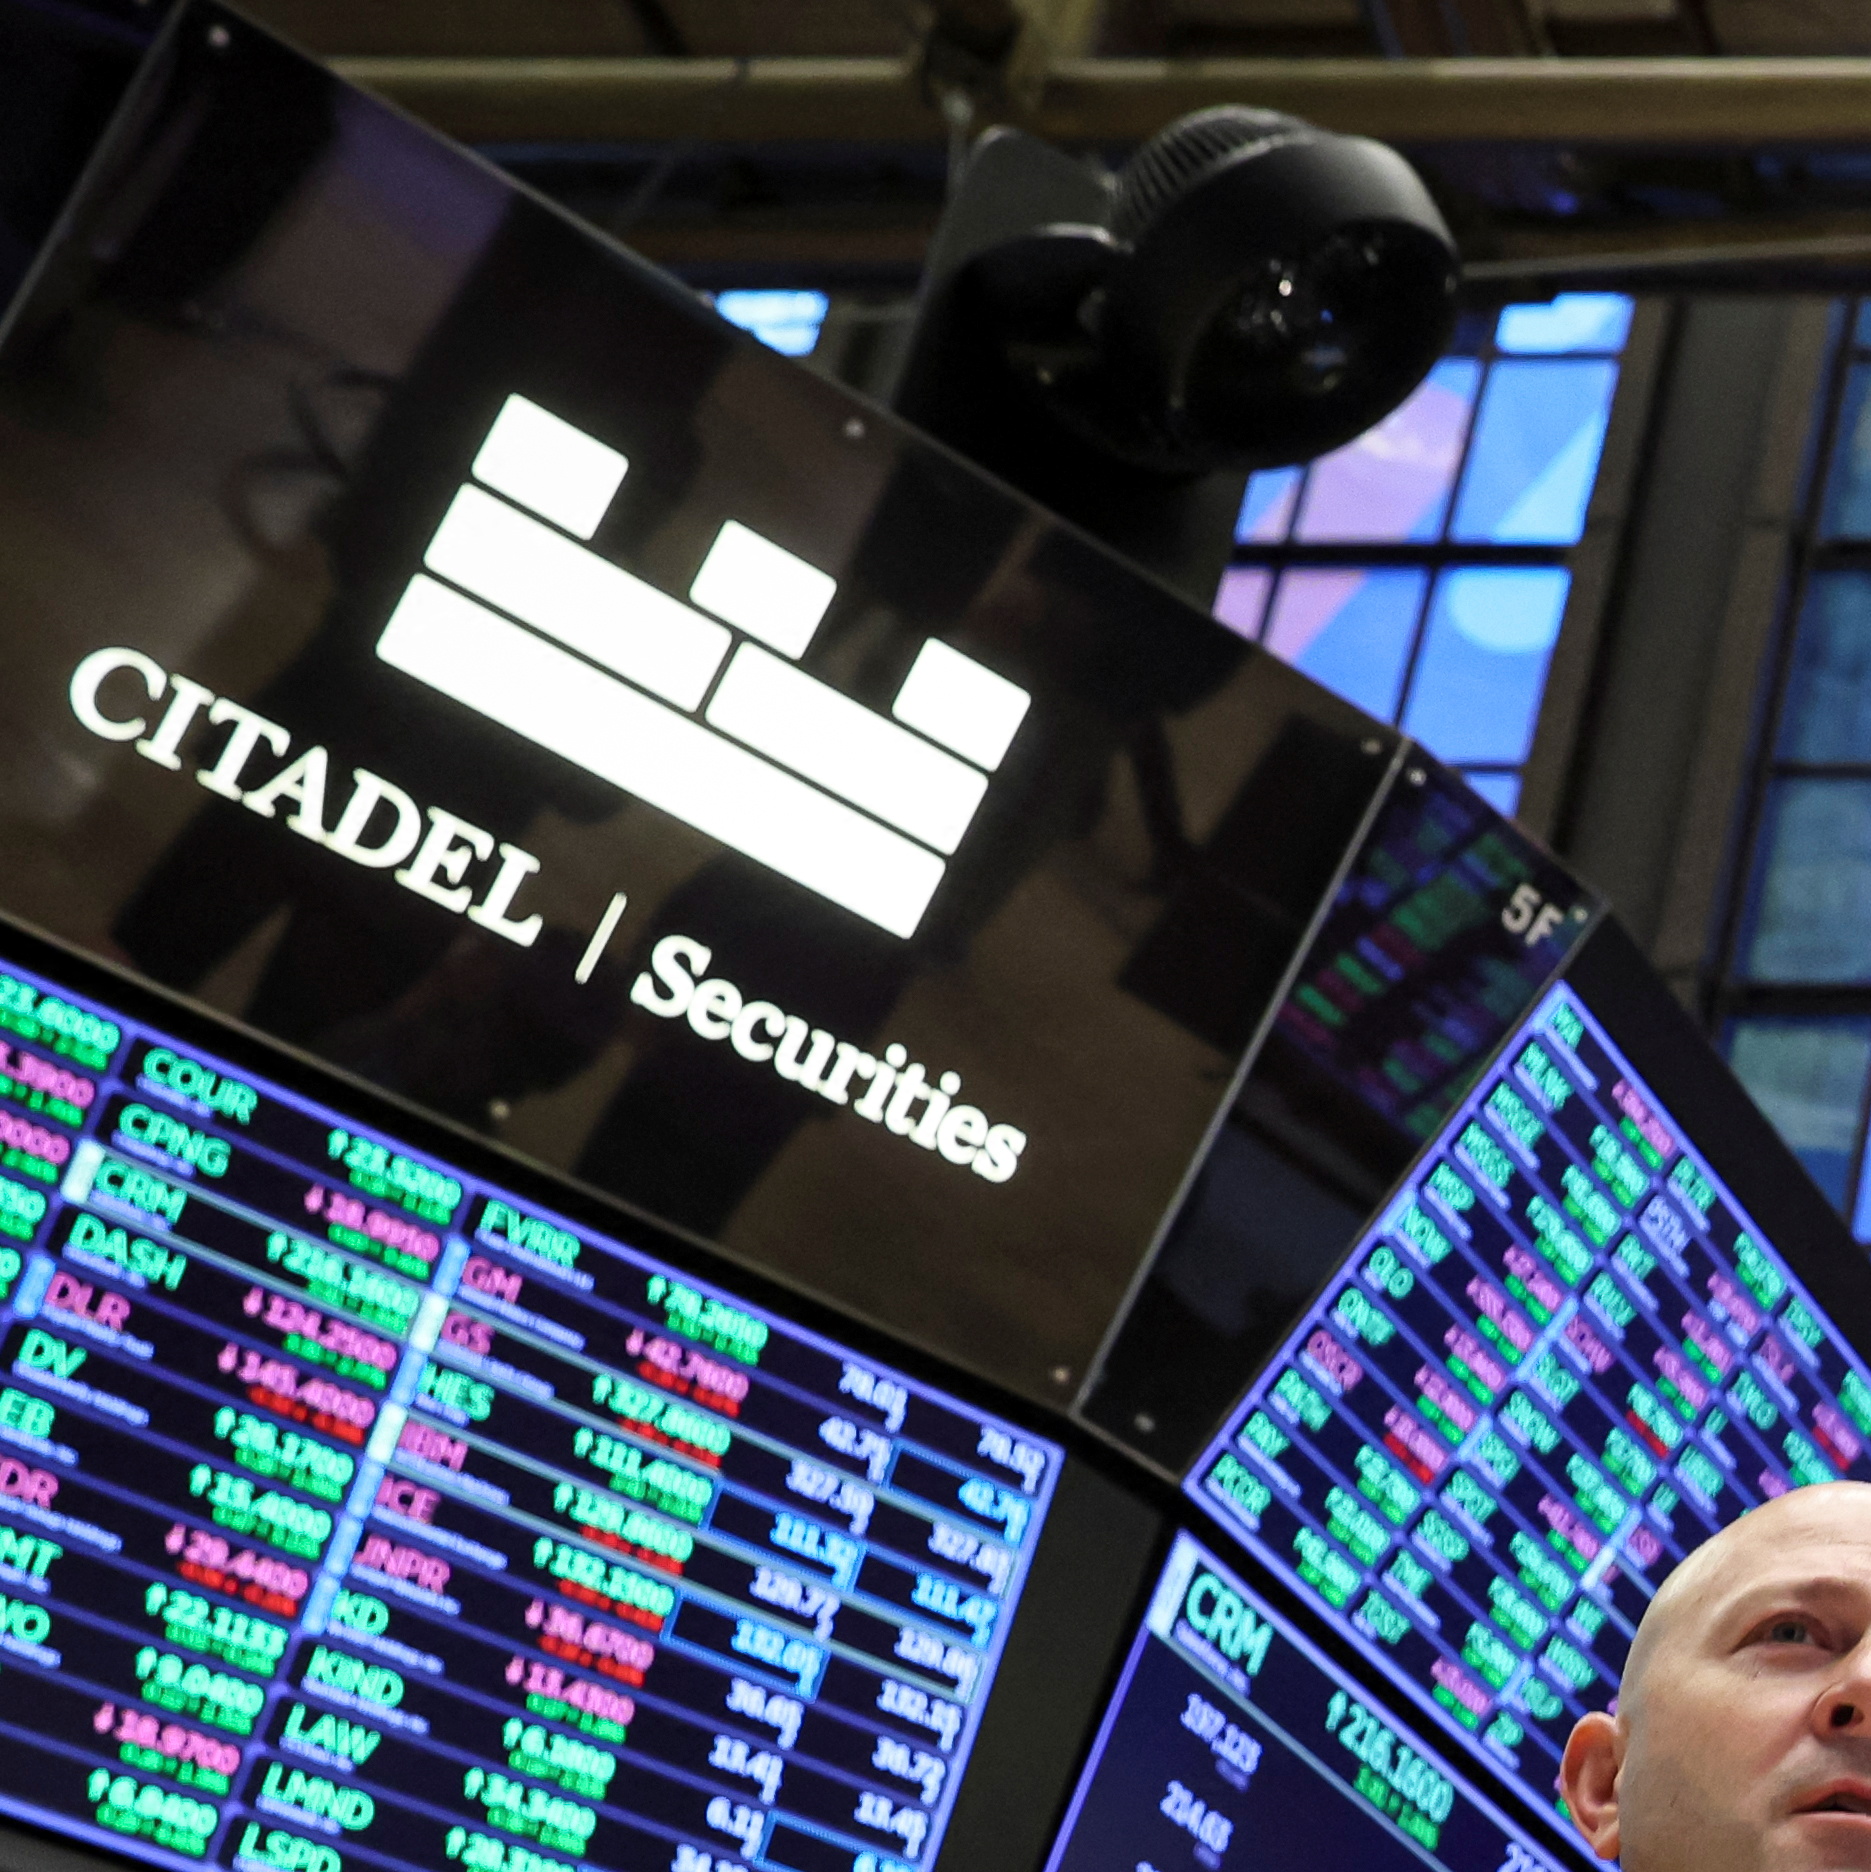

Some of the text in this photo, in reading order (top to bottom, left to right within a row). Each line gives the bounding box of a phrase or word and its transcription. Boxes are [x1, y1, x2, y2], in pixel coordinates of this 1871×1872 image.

[67, 644, 1030, 1184] CITADEL Securities
[1501, 884, 1568, 948] 5F
[141, 1043, 258, 1121] COUR
[118, 1103, 230, 1175] CPNG
[94, 1154, 188, 1221] CRM
[68, 1213, 186, 1287] DASH
[480, 1198, 582, 1266] FVRR
[44, 1268, 130, 1330] DLR
[461, 1255, 522, 1302] GM
[18, 1328, 86, 1381] DV
[440, 1308, 497, 1354] GS
[0, 1387, 55, 1438] EB
[417, 1360, 494, 1419] HES
[397, 1418, 469, 1470] IBM
[375, 1471, 440, 1523] ICE
[354, 1531, 450, 1593] JNPR
[329, 1583, 389, 1637] KD
[307, 1644, 404, 1708] KIND
[1186, 1565, 1273, 1674] CRM
[1339, 1703, 1453, 1822] 216.1600
[284, 1701, 380, 1762] LAW
[262, 1760, 374, 1829] LMND
